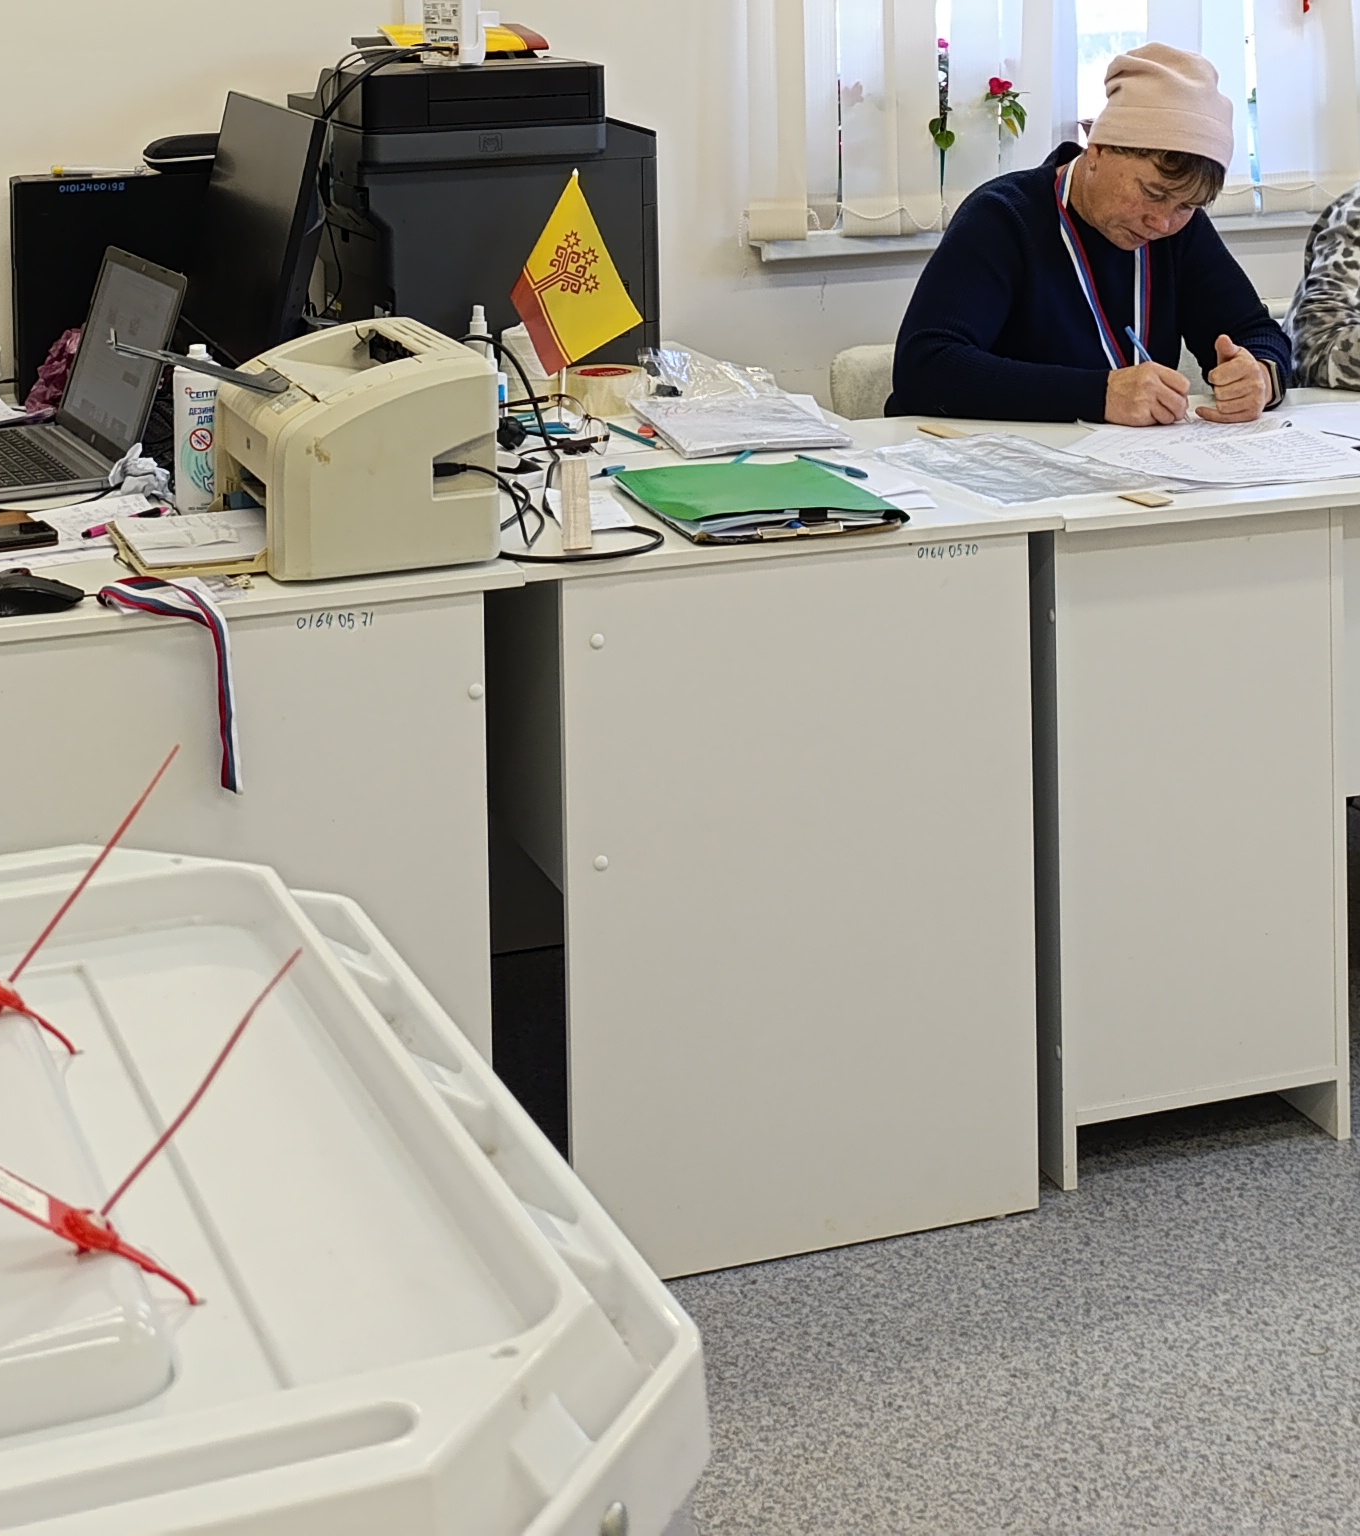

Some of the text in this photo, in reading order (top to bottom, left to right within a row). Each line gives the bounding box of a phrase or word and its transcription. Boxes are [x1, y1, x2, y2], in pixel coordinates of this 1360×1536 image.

[917, 543, 979, 560] 0164 0570
[296, 612, 334, 630] 0164
